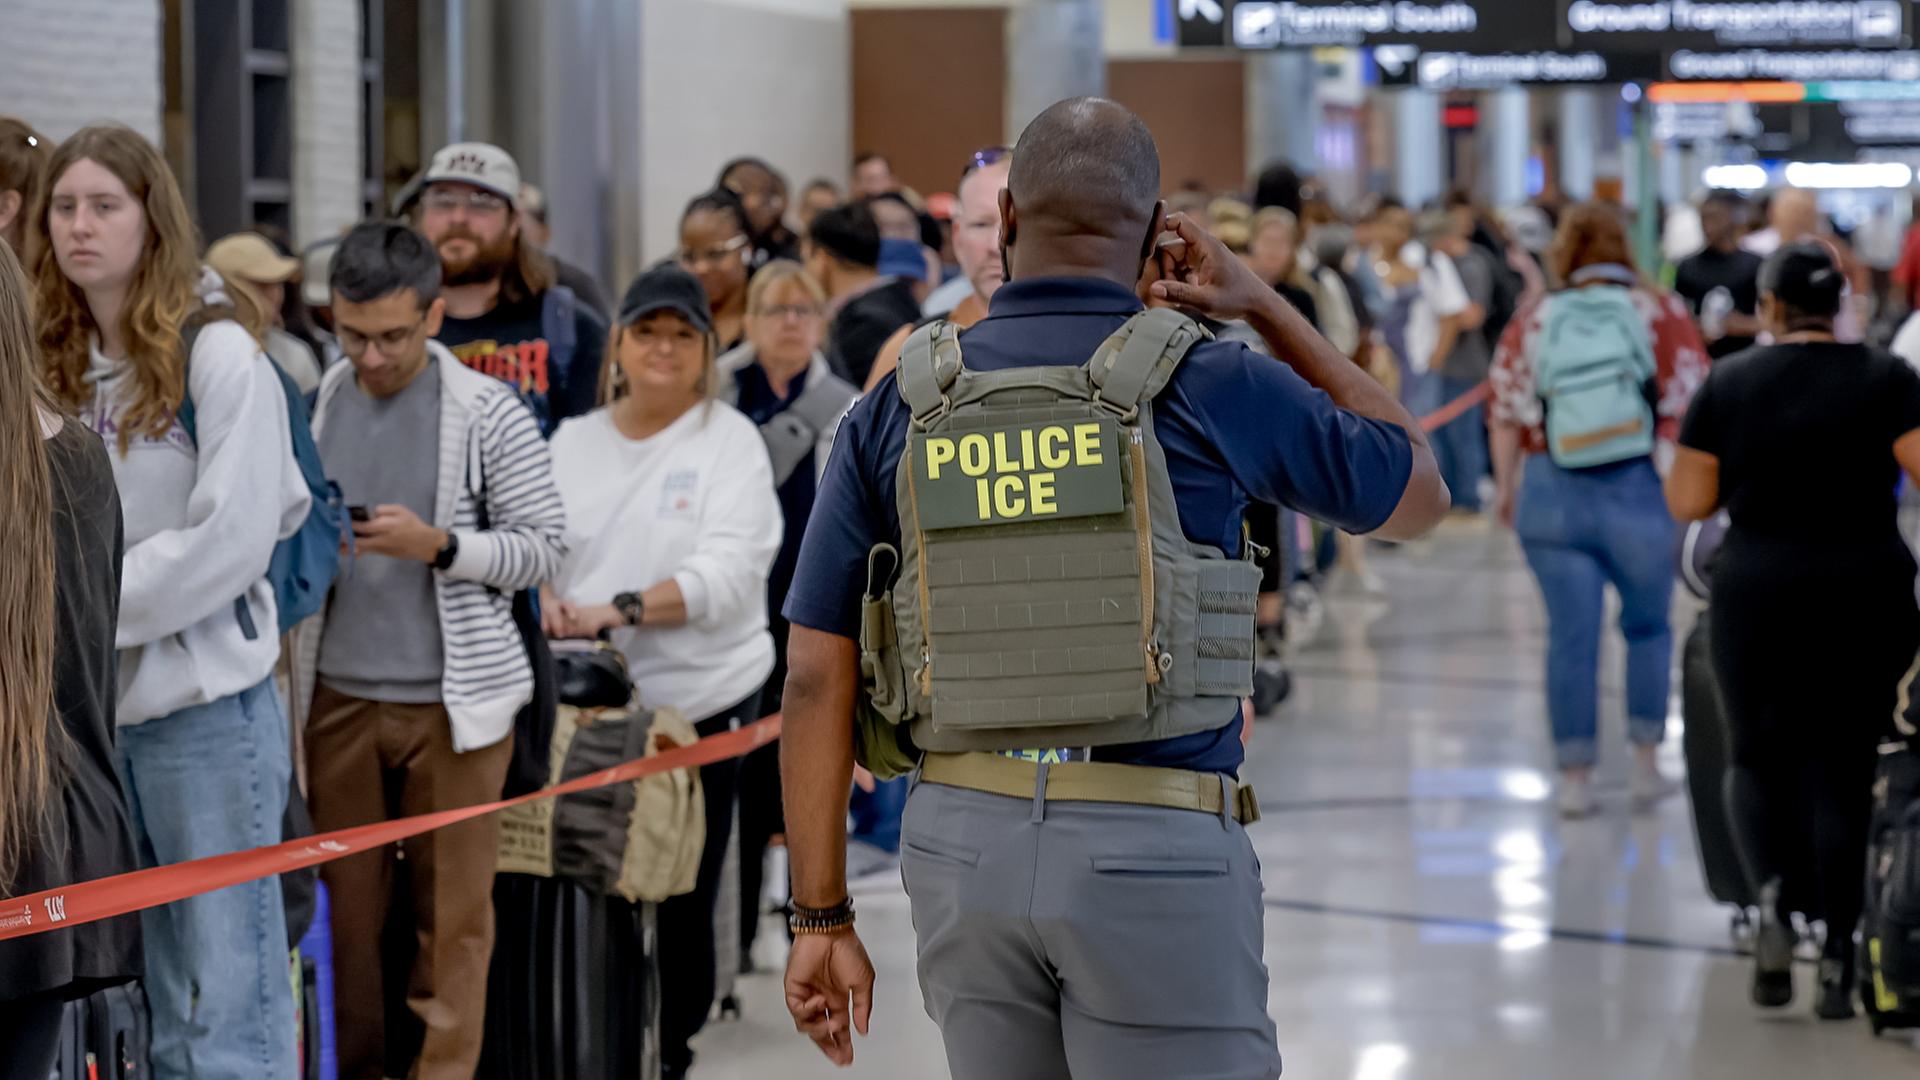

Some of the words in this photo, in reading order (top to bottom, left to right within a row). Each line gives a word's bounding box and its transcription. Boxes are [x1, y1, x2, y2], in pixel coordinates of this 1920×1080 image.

[1394, 0, 1477, 32] South
[1568, 0, 1670, 32] Ground
[925, 423, 1103, 480] POLICE
[976, 472, 1057, 520] ICE
